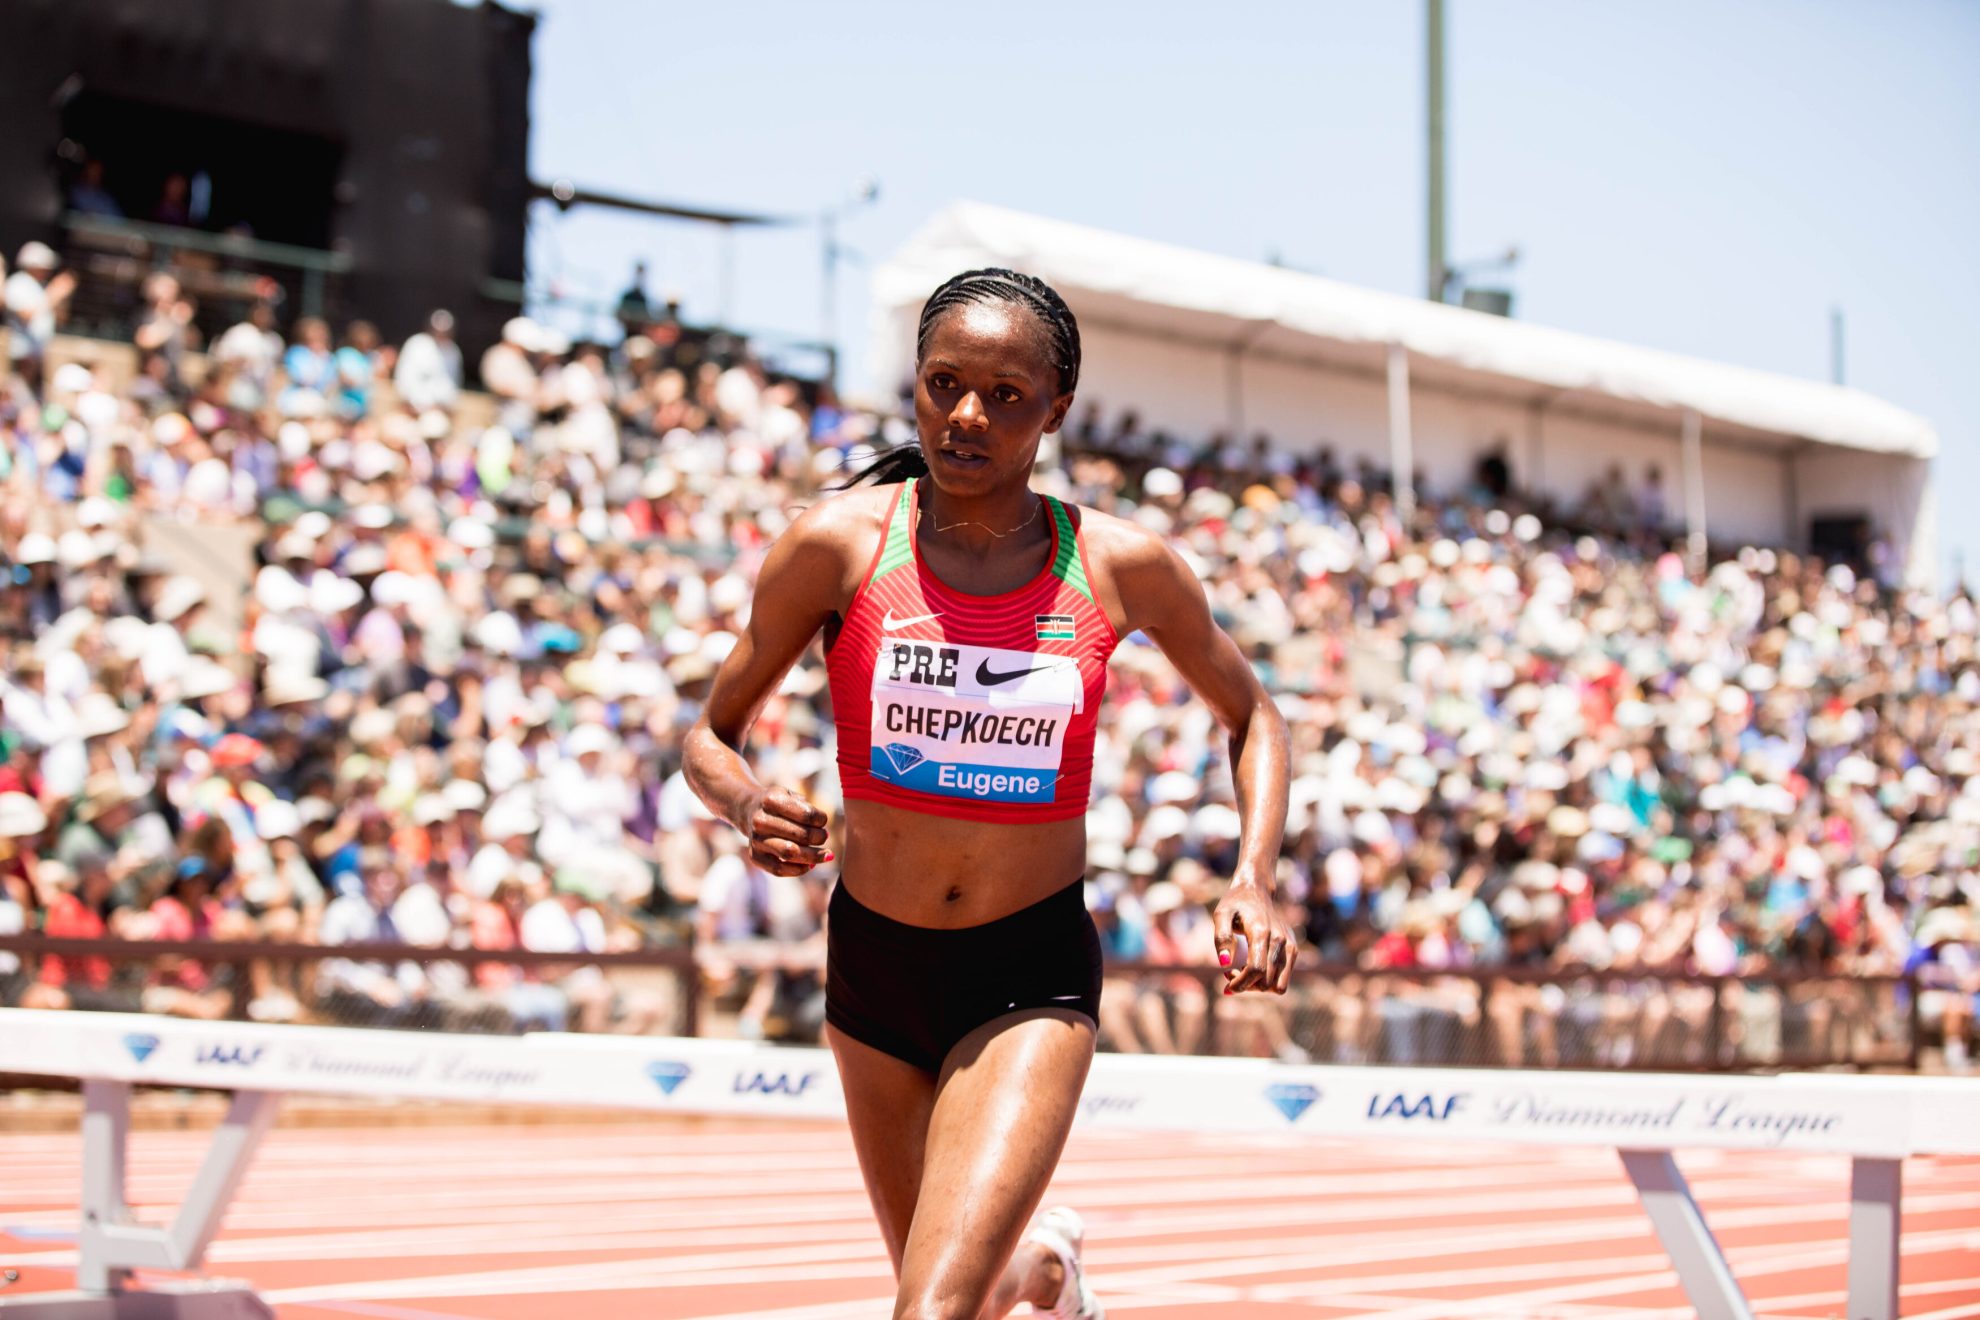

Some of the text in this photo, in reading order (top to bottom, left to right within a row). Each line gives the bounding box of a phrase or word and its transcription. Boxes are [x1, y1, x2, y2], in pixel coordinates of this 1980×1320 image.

[889, 643, 959, 687] PRE
[886, 703, 1056, 747] CHEPKOECH
[938, 765, 1040, 796] Eugene
[733, 1072, 822, 1096] IAAF
[1367, 1090, 1842, 1147] IAAF Diamond League
